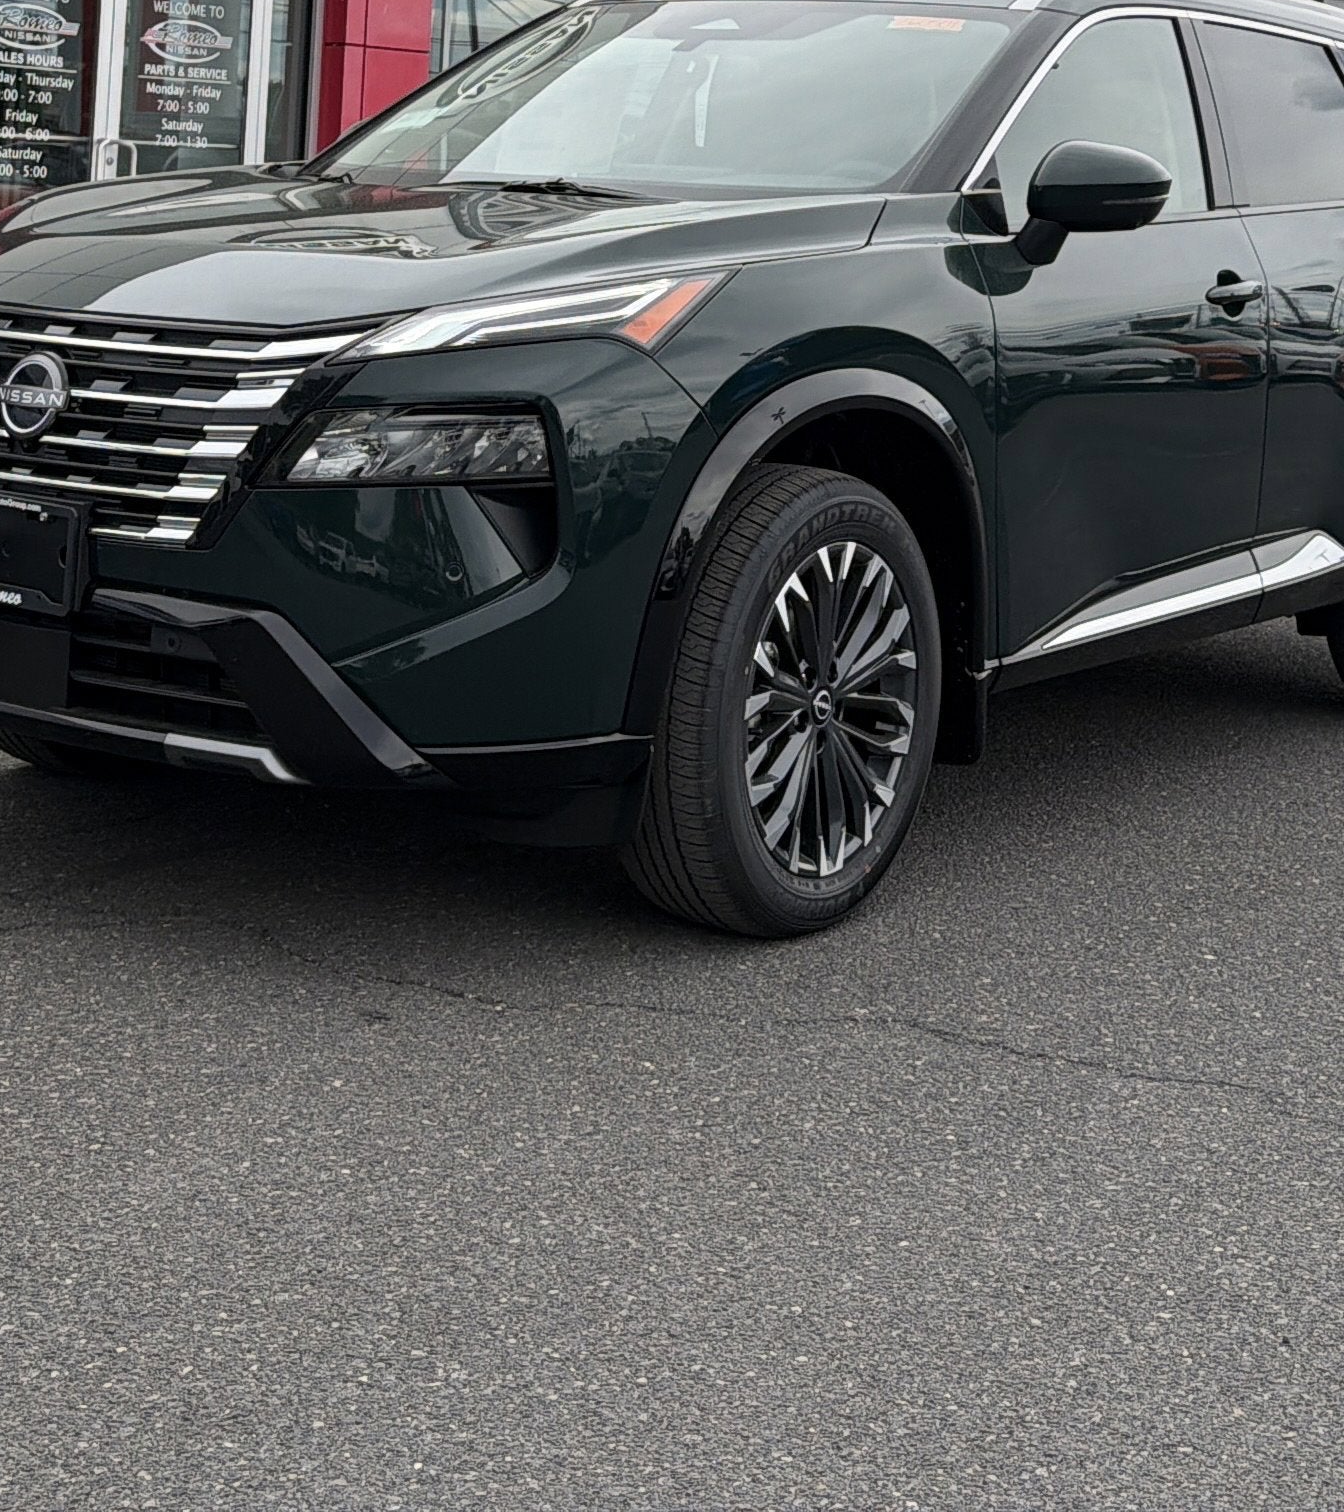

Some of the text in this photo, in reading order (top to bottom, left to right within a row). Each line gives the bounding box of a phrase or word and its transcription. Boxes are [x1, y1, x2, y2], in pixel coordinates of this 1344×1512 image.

[153, 0, 225, 19] WELCOME TO
[0, 6, 63, 31] Romeo
[4, 29, 51, 42] NISSAN
[162, 22, 218, 46] Romeo
[165, 45, 208, 56] NISSAN
[26, 53, 64, 68] HOURS
[144, 63, 228, 81] PARTS & SERVICE
[25, 72, 75, 92] Thursday
[28, 90, 53, 105] 7:00
[145, 81, 185, 97] Monday
[192, 85, 222, 101] Friday
[156, 99, 180, 113] 7:00
[187, 102, 210, 115] 5:00
[5, 108, 39, 125] Friday
[161, 118, 204, 134] Saturday
[25, 128, 51, 141] 6:00
[155, 134, 178, 148] 7:00
[186, 136, 208, 149] 1:30
[22, 165, 48, 179] 5:00
